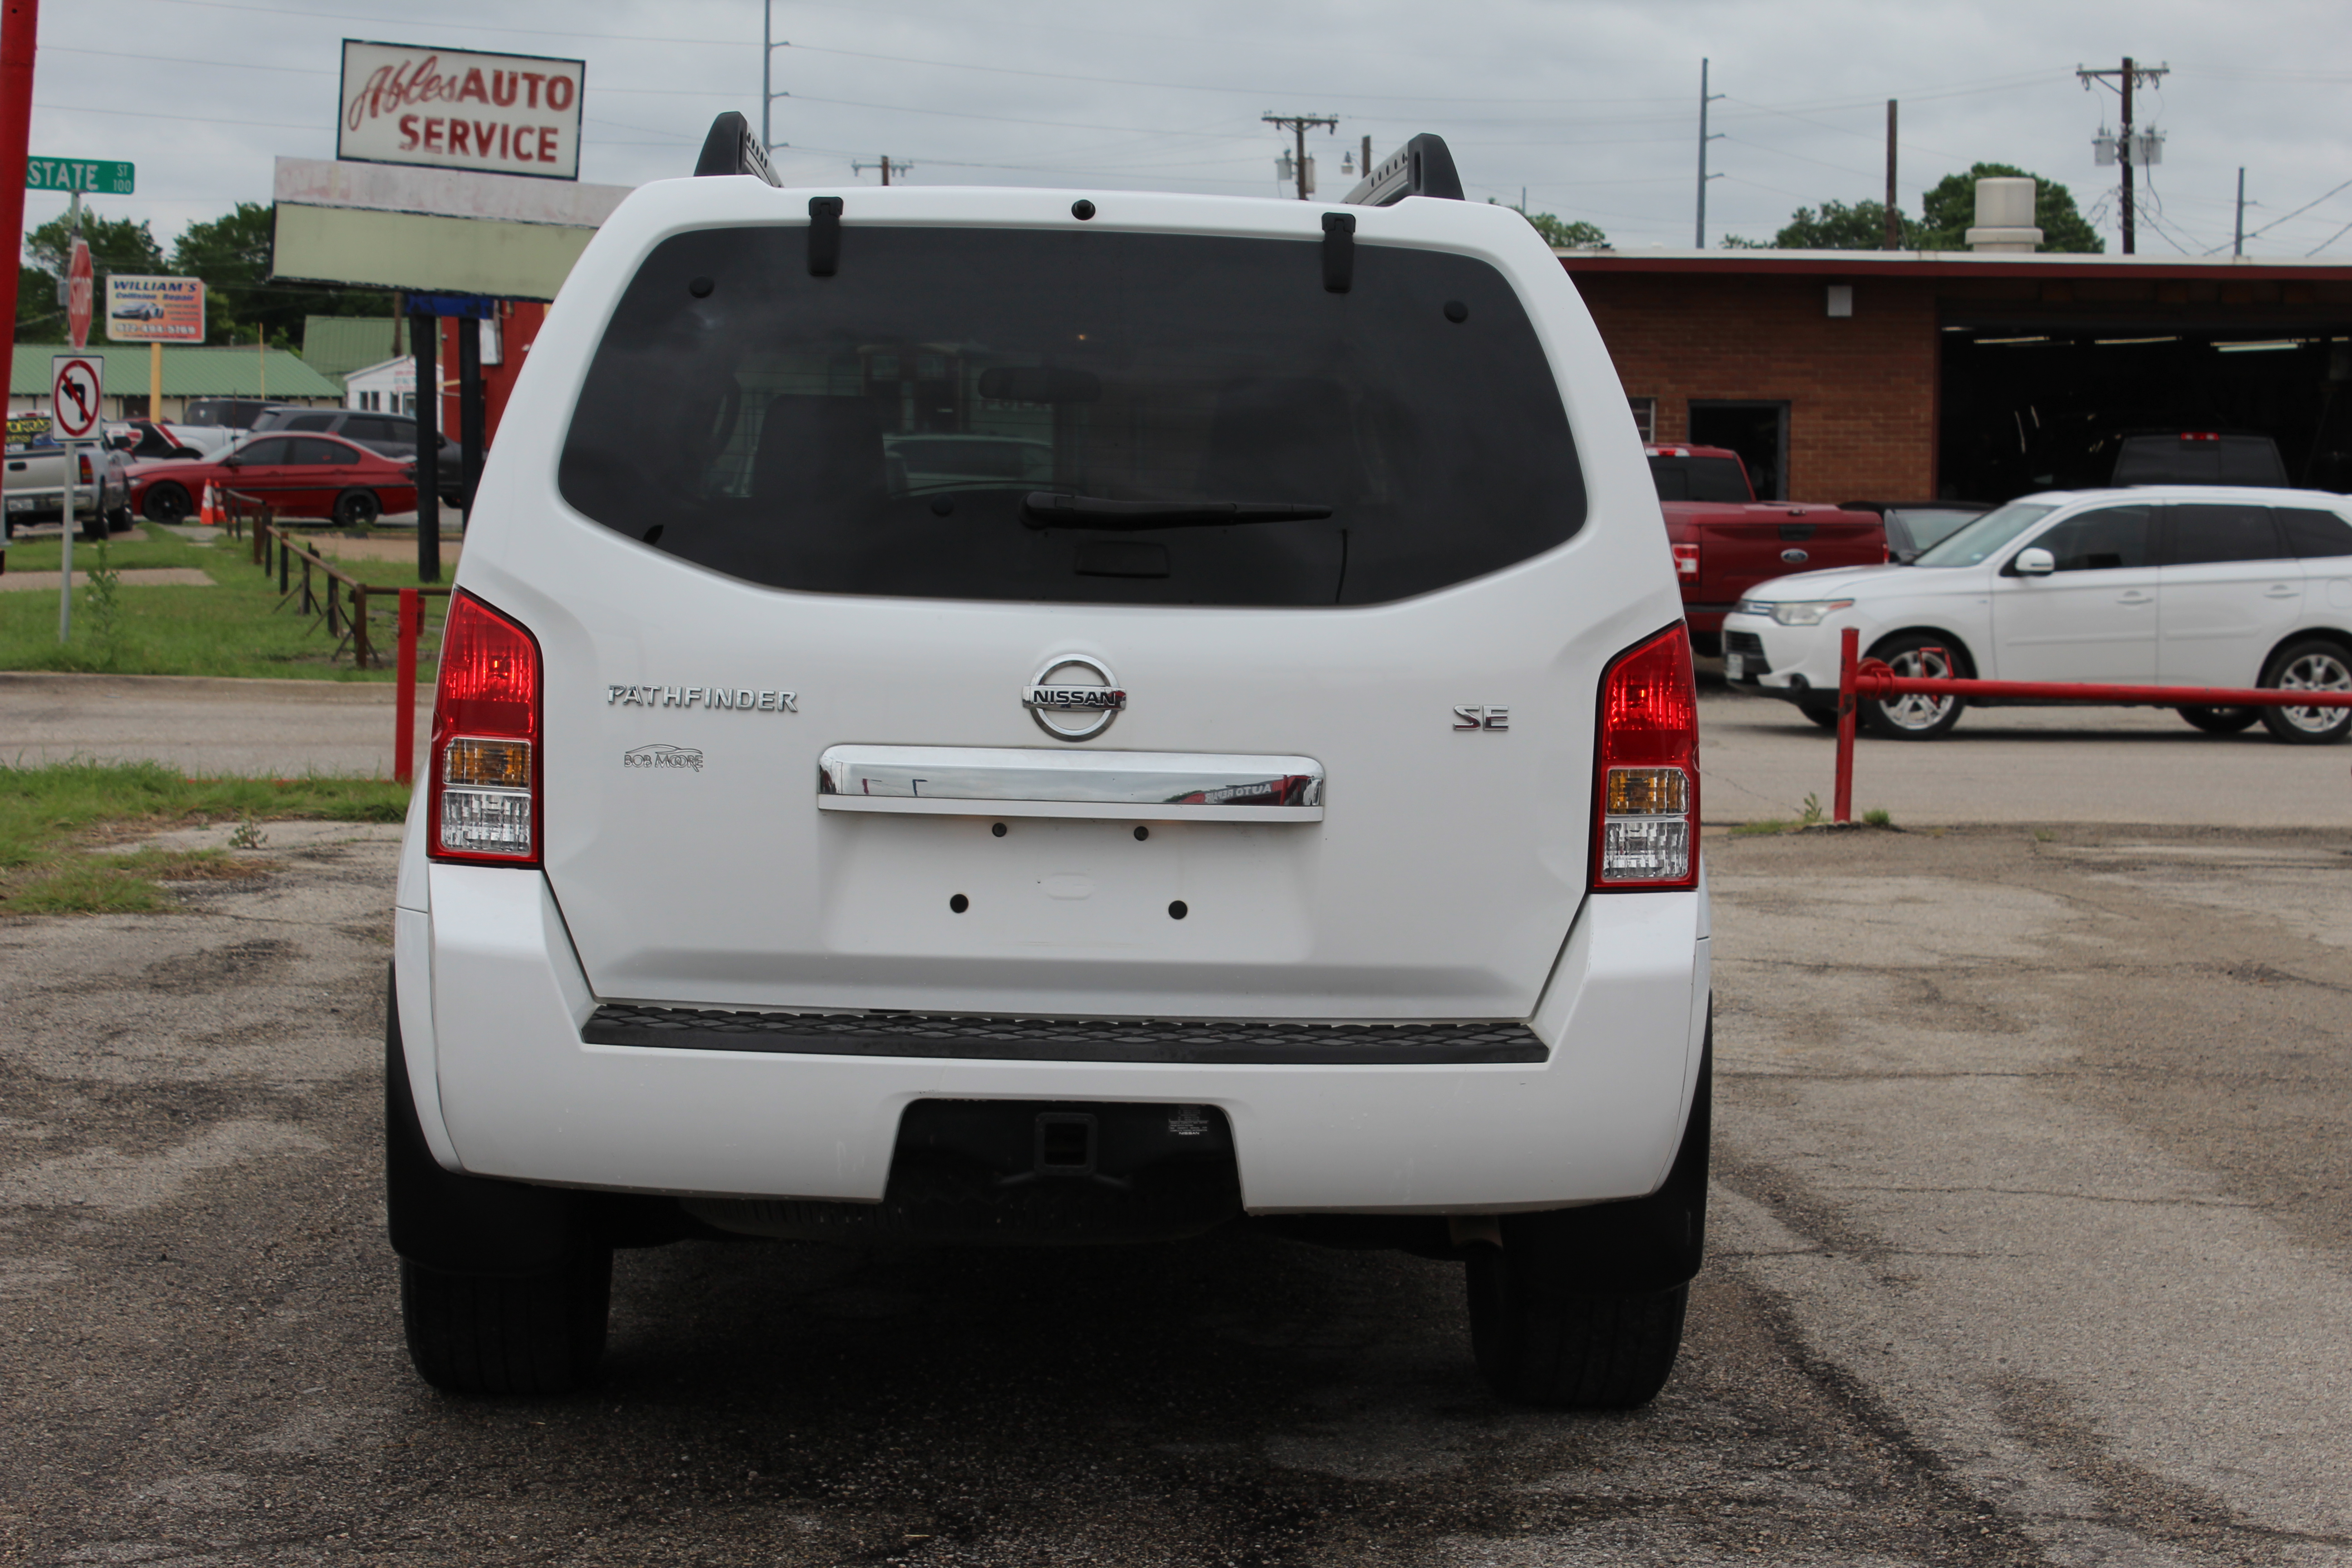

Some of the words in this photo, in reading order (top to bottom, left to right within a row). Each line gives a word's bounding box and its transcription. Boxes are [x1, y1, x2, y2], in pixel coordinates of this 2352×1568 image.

[456, 67, 574, 112] AUTO
[398, 113, 559, 163] SERVICE
[27, 161, 98, 191] STATE
[117, 164, 128, 177] ST
[113, 179, 132, 192] 100
[114, 280, 197, 293] WILLIAM'S
[115, 292, 157, 300] Collision
[162, 293, 195, 301] Repair
[608, 683, 798, 713] PATHFINDER
[1033, 690, 1116, 706] NISSAN
[1453, 705, 1509, 731] SE
[624, 754, 652, 768] BOB
[655, 754, 703, 772] MOORE
